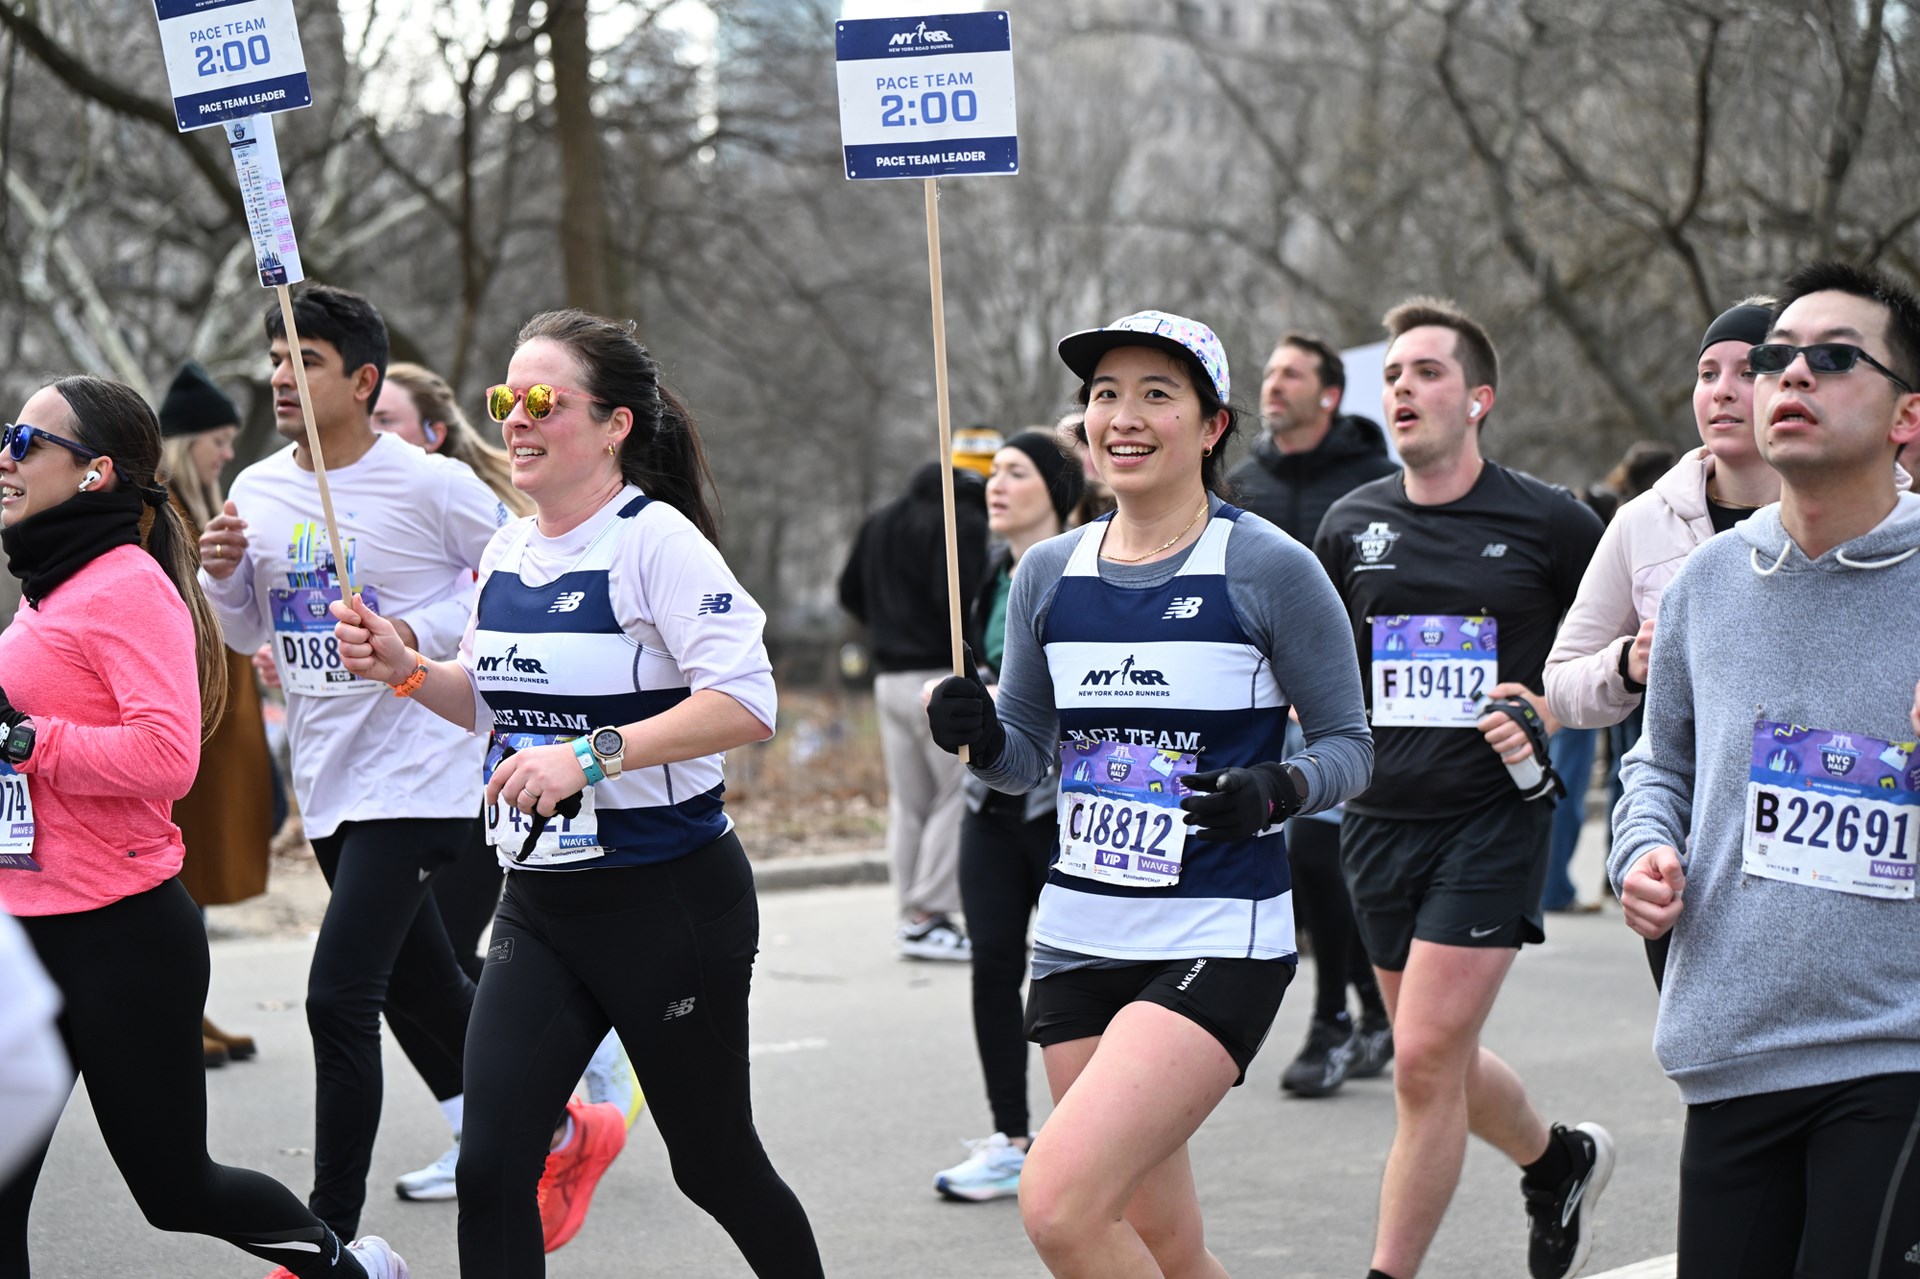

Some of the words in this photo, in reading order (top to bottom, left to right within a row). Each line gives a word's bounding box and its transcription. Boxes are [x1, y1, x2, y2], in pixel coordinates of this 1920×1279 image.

[190, 26, 222, 43] PACE
[224, 17, 266, 36] TEAM
[195, 34, 271, 77] 2:00
[876, 76, 919, 90] PACE
[924, 72, 974, 87] TEAM
[199, 102, 222, 114] PACE
[223, 97, 248, 110] TEAM
[249, 89, 286, 105] LEADER
[881, 89, 977, 127] 2:00
[876, 156, 906, 167] PACE
[907, 153, 940, 165] TEAM
[942, 151, 986, 163] LEADER
[282, 636, 341, 669] D188
[492, 709, 518, 727] ACE
[518, 709, 591, 730] TEAM
[1124, 728, 1201, 750] TEAM
[1110, 762, 1127, 772] NYC
[1827, 753, 1850, 765] NYC
[1827, 763, 1848, 772] HALF
[12, 826, 28, 835] WAVE
[28, 826, 34, 834] 3
[561, 838, 587, 846] WAVE
[1102, 852, 1121, 866] VIP
[1141, 859, 1169, 873] WAVE
[1170, 865, 1177, 874] 3
[1873, 863, 1906, 876] WAVE
[1907, 866, 1914, 876] 3
